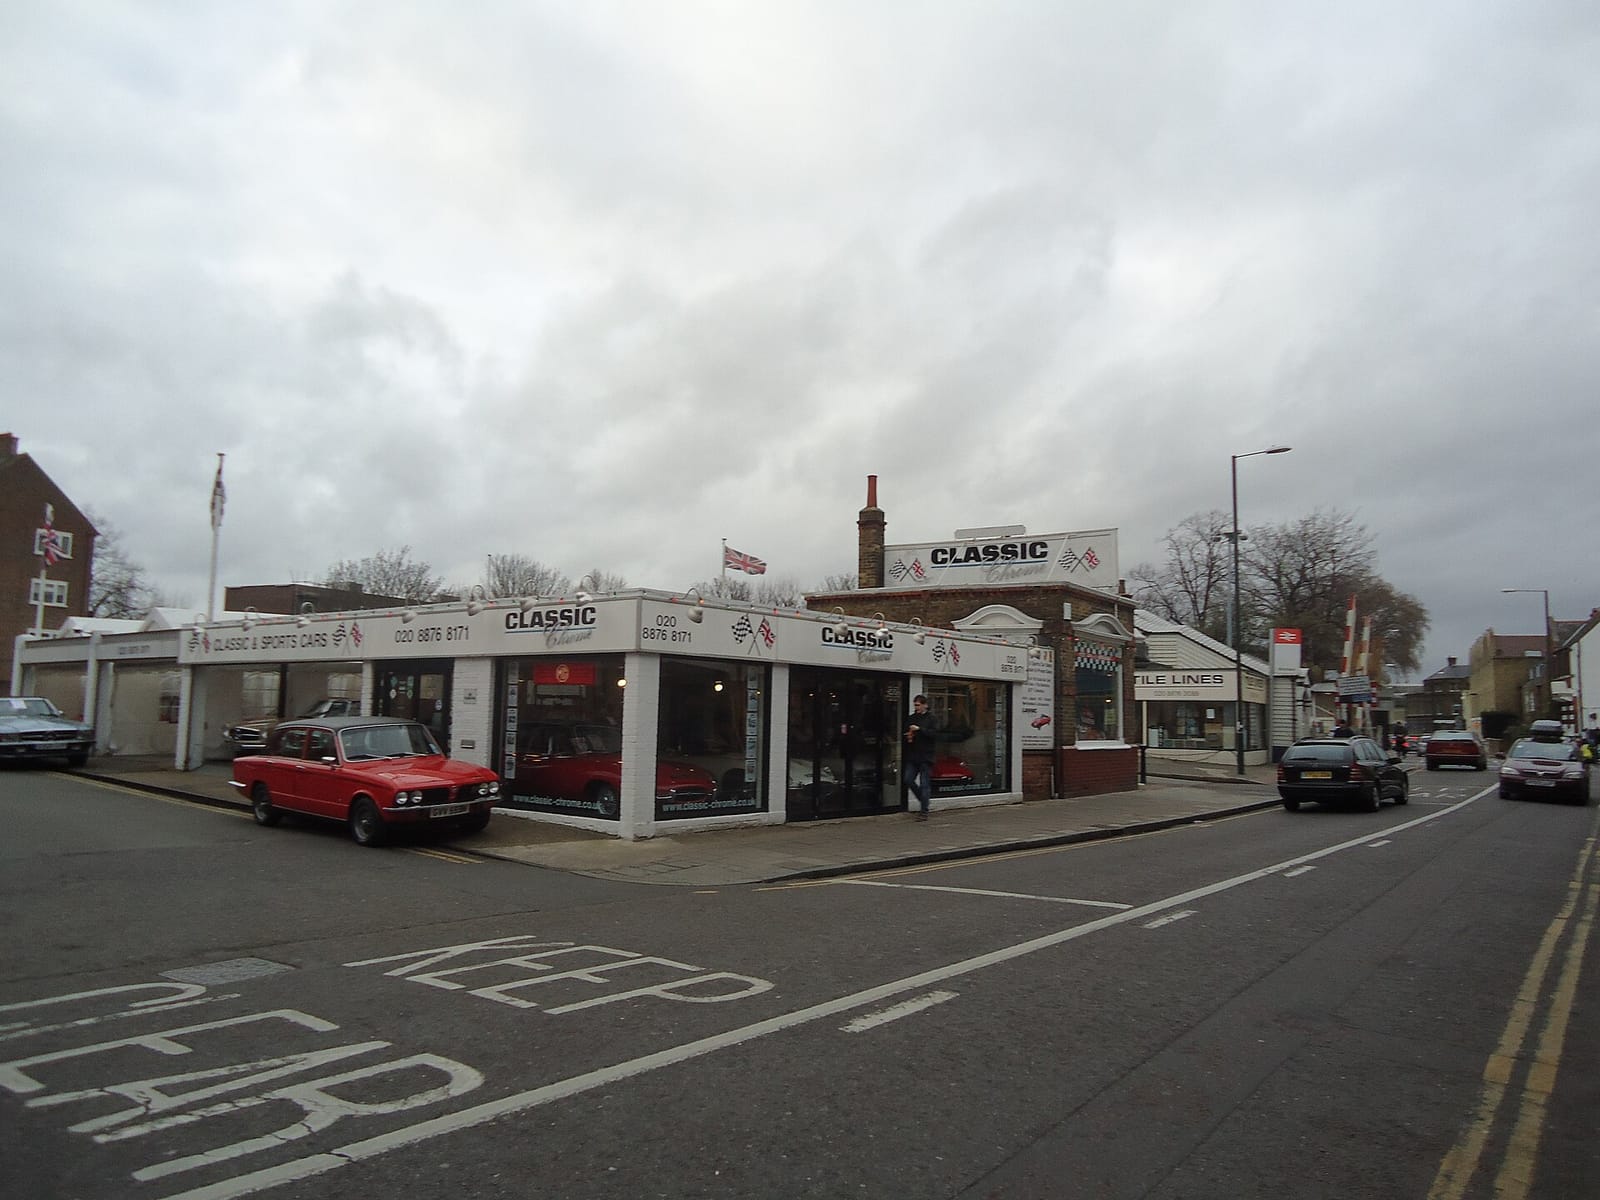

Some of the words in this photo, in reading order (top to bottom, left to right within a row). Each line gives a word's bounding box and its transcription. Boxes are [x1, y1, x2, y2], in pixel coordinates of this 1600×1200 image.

[931, 541, 1048, 565] CLASSIC
[505, 606, 596, 630] CLASSIC
[656, 614, 677, 628] 020
[214, 637, 249, 651] CLASSIC
[261, 634, 297, 650] SPORTS
[301, 632, 328, 648] CARS
[395, 629, 414, 643] 020
[417, 627, 442, 642] 8876
[446, 625, 469, 641] 8171
[642, 627, 667, 641] 8876
[671, 630, 692, 643] 8171
[822, 627, 893, 649] CLASSIC
[1172, 674, 1224, 685] LINES
[342, 935, 775, 1014] KEEP
